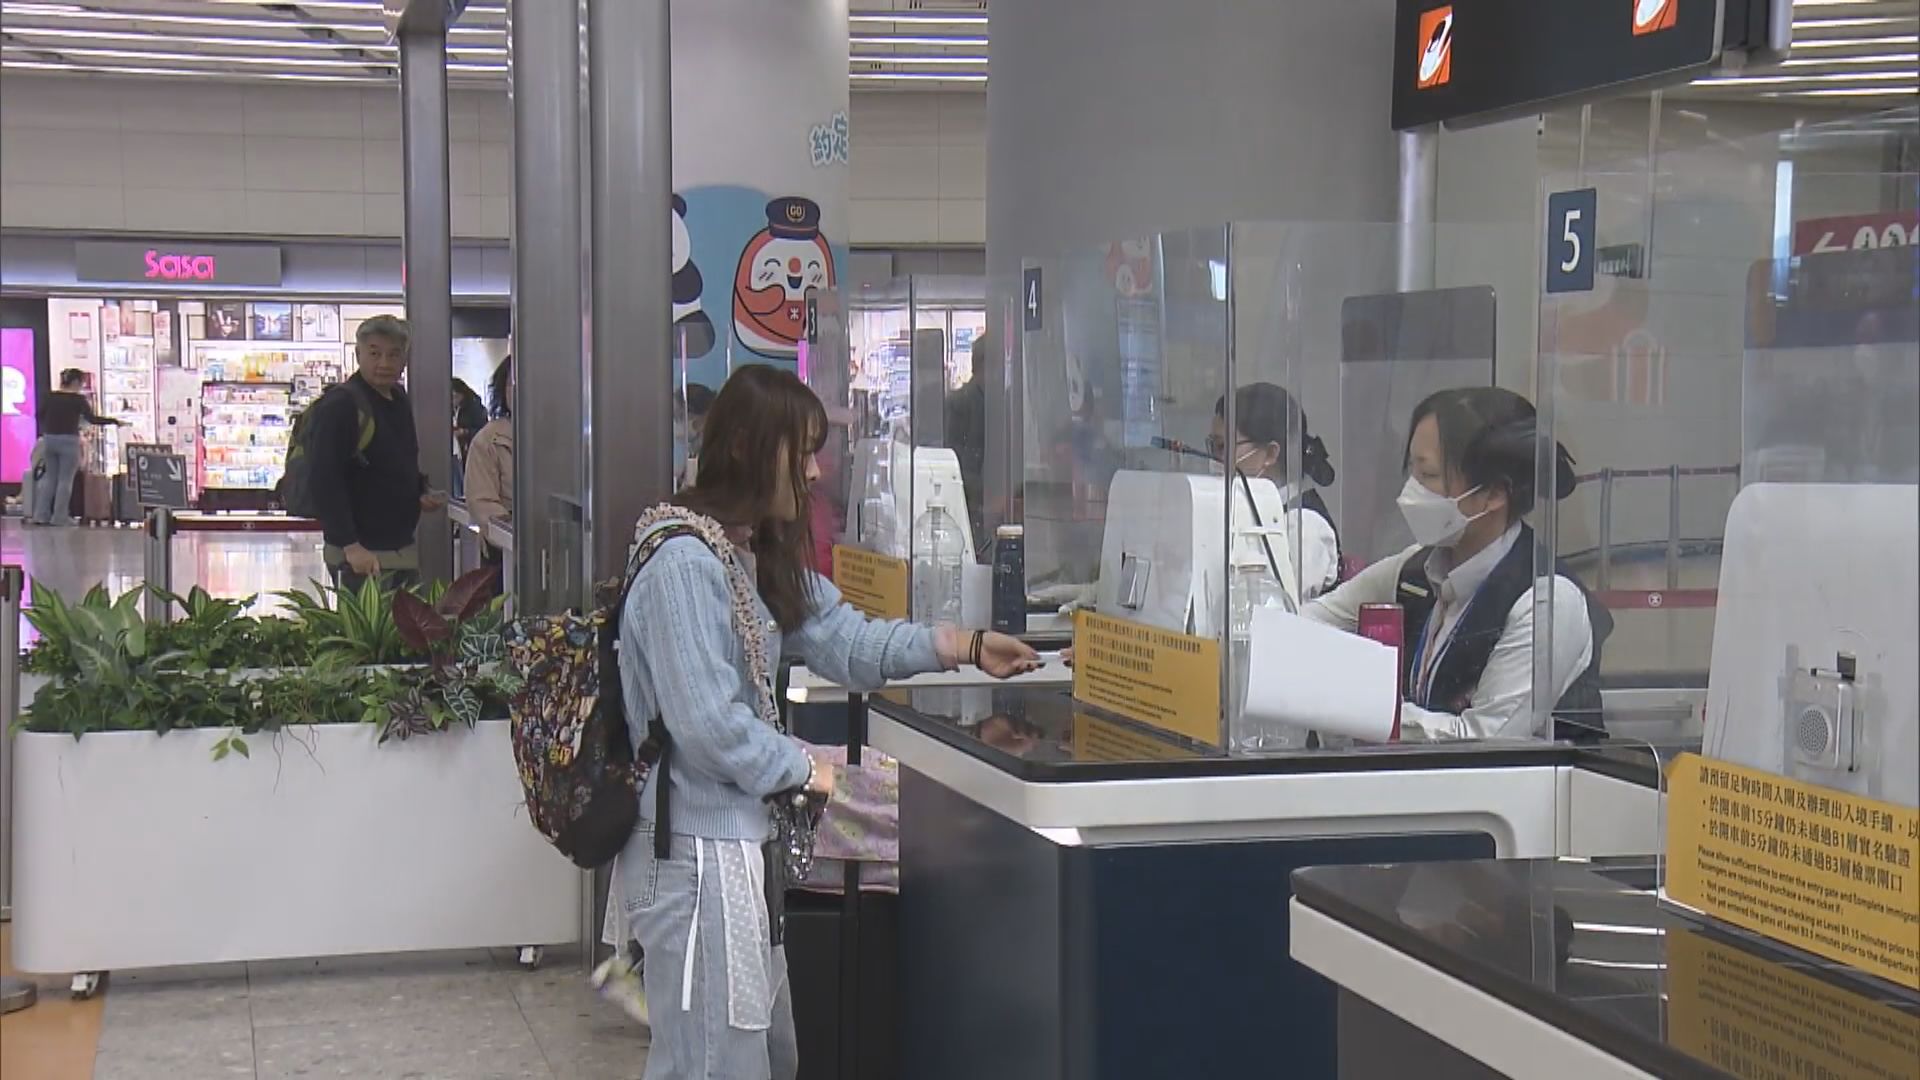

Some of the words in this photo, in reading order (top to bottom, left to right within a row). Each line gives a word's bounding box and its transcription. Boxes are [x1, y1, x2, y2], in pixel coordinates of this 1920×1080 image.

[1561, 209, 1581, 272] 5
[145, 250, 214, 279] Sasa
[1028, 280, 1037, 318] 4
[810, 308, 816, 335] 3
